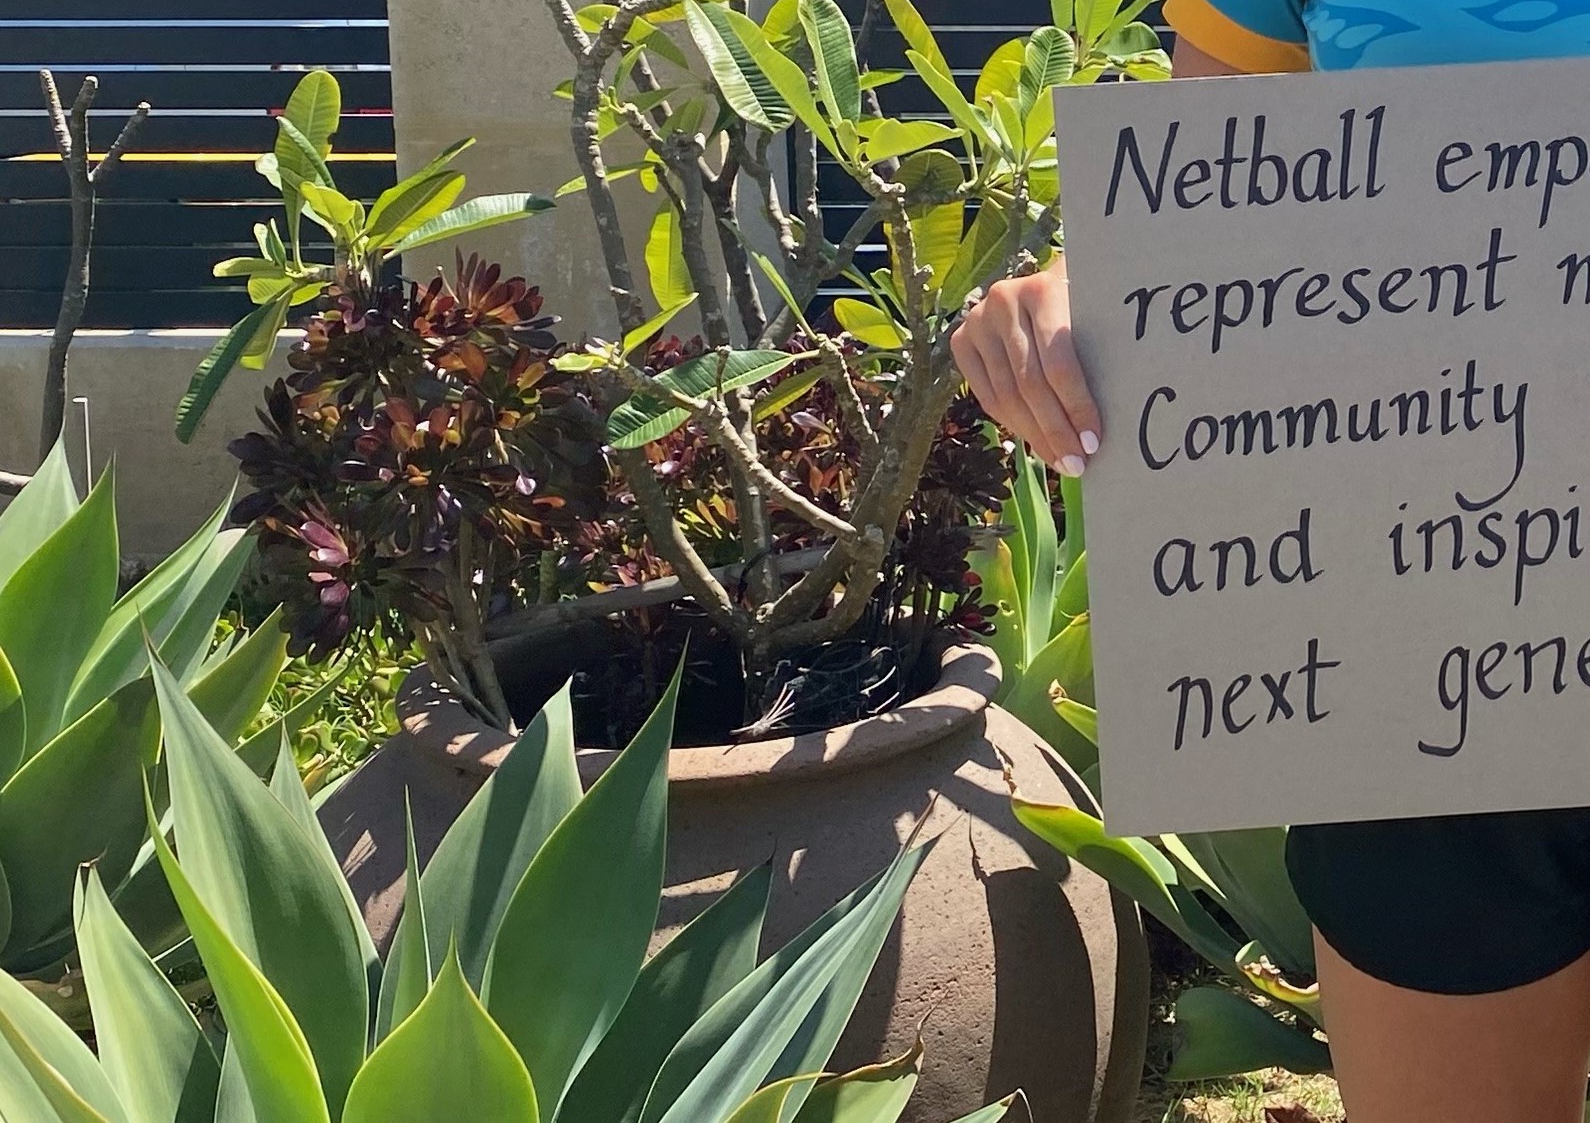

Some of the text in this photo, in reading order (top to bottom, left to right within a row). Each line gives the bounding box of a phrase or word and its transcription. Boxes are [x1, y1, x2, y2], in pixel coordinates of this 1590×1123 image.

[1105, 106, 1386, 217] Netball
[1123, 227, 1518, 354] represent
[1138, 360, 1529, 511] Community
[1153, 508, 1325, 597] and
[1166, 637, 1342, 751] next
